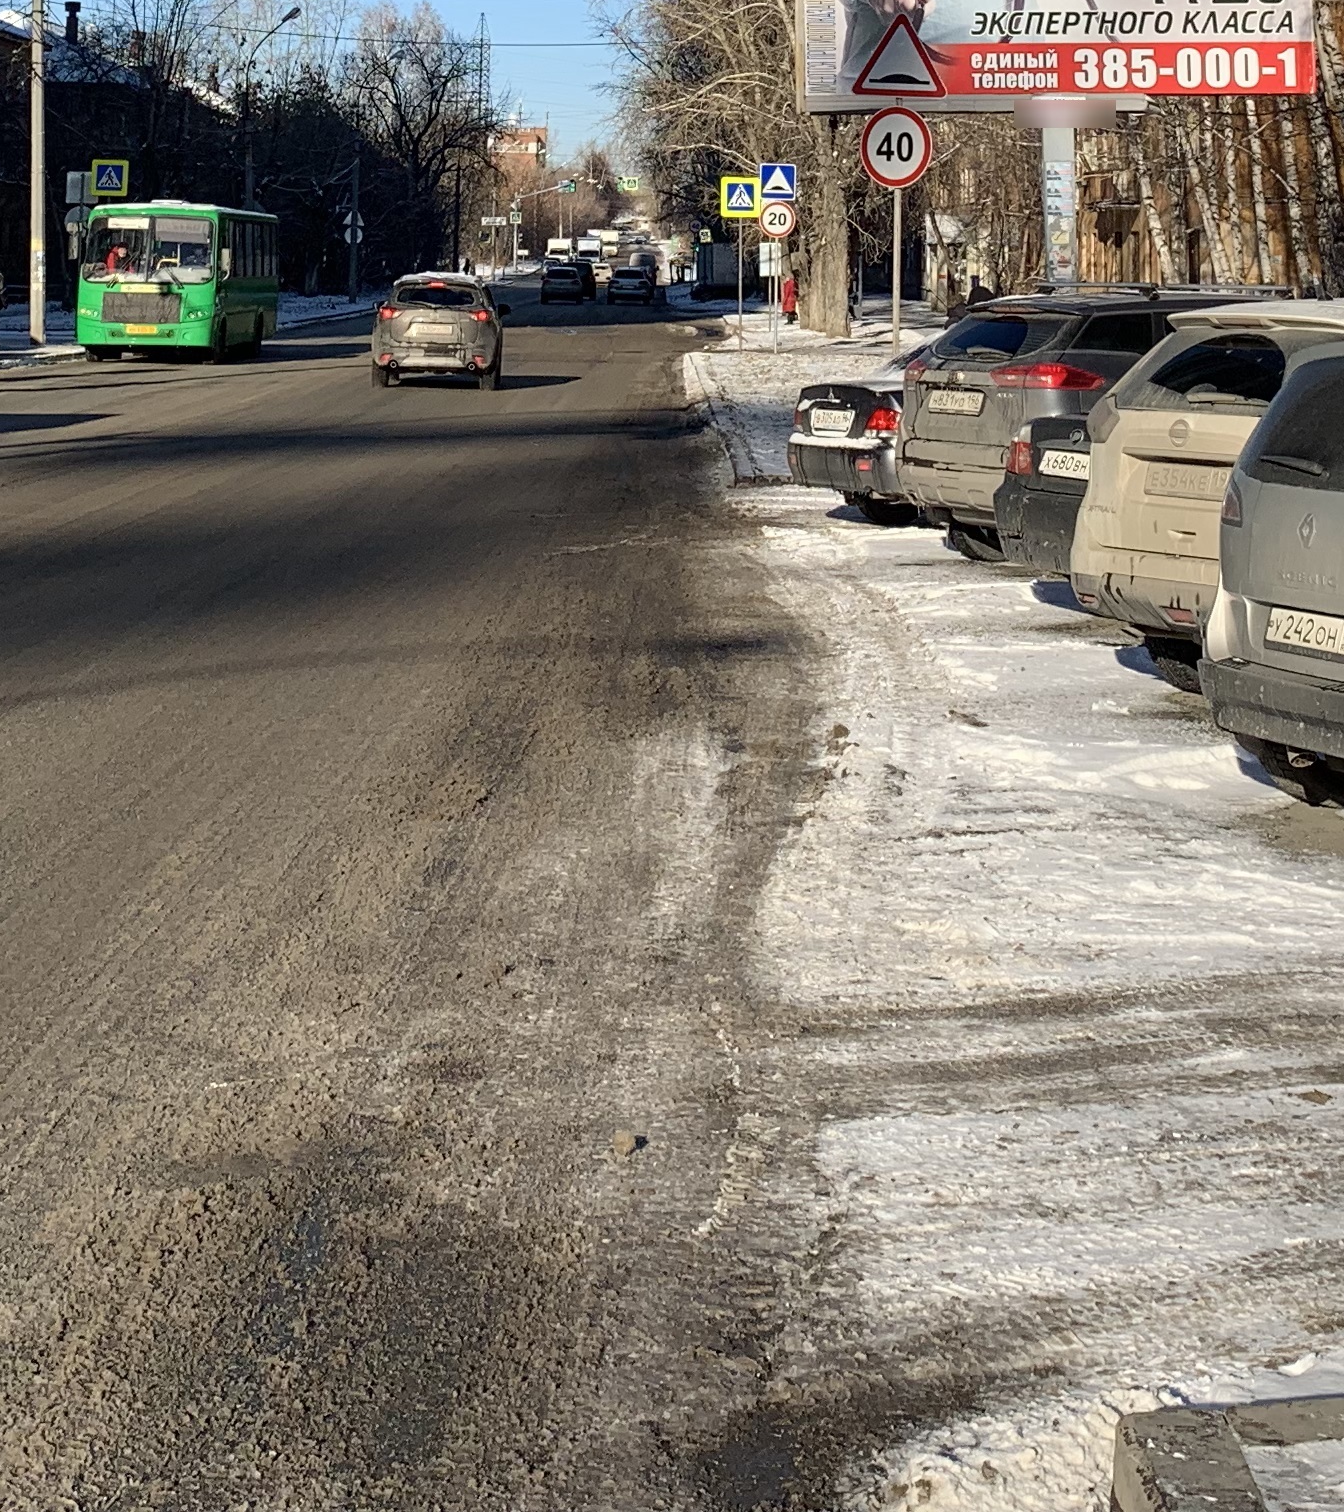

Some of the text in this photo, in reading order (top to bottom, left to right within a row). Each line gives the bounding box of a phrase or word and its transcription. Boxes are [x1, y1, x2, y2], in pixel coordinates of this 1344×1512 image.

[970, 9, 1295, 37] ЭКСПЕРТНОГО КЛАССА
[970, 47, 1059, 70] единый
[1073, 47, 1297, 89] 385-000-1
[971, 71, 1059, 91] телефон
[875, 131, 914, 162] 40
[767, 212, 787, 226] 20
[1274, 615, 1338, 648] У242ОН
